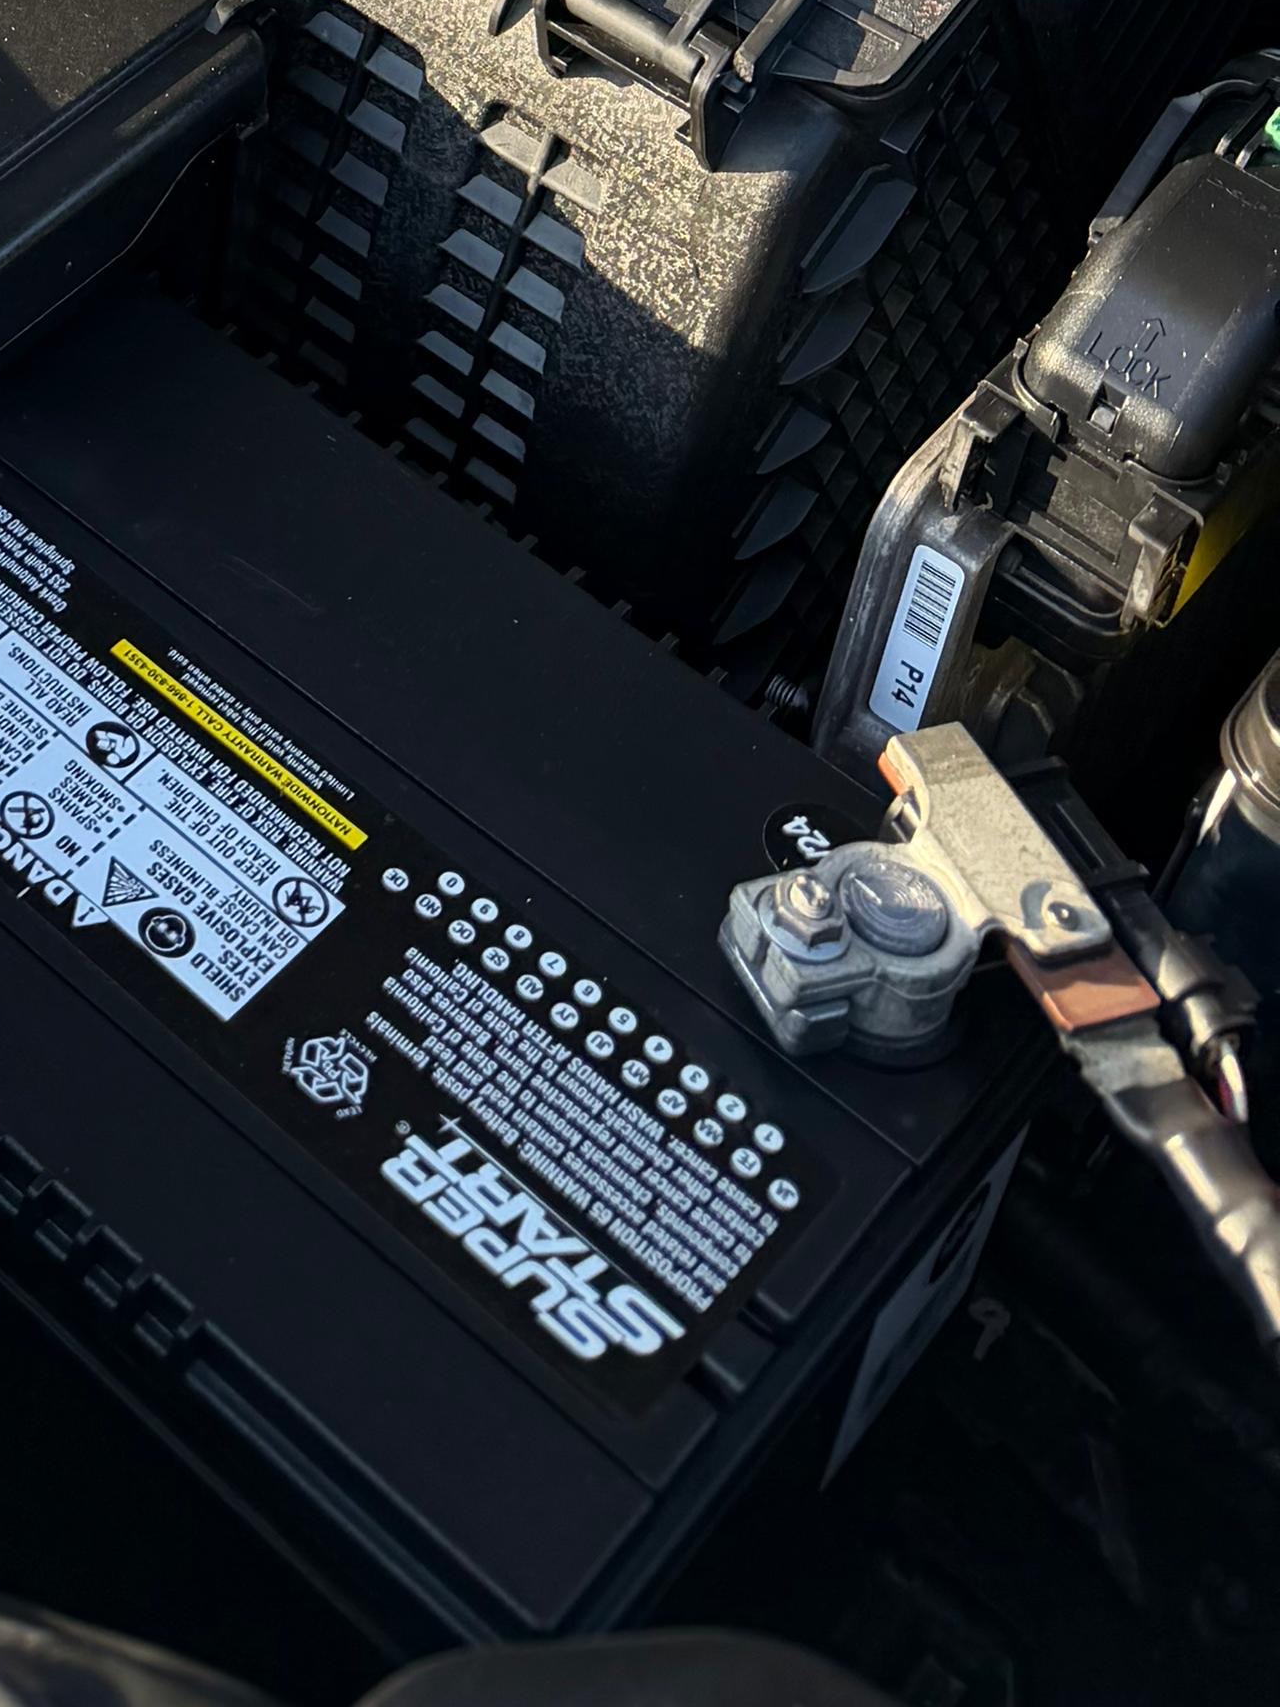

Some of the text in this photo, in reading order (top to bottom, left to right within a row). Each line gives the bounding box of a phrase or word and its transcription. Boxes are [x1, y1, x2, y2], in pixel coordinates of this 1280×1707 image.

[1084, 331, 1172, 399] LOCK
[6, 518, 29, 537] MO
[22, 531, 75, 575] Springfield
[23, 552, 53, 579] South
[37, 585, 68, 613] Ozark
[39, 620, 88, 661] PROPER
[41, 642, 71, 667] NOT
[7, 642, 92, 718] INSTRUCTIONS.
[65, 661, 91, 681] DO
[82, 656, 133, 698] FOLLOW
[86, 674, 130, 715] BURNS.
[891, 660, 925, 708] P14
[0, 698, 48, 740] SEVERE
[23, 676, 81, 728] READ ALL
[124, 709, 150, 730] OR
[131, 692, 159, 721] USE.
[195, 704, 224, 732] CALL
[141, 724, 209, 780] EXPLOSION
[154, 715, 214, 764] INVERTED
[221, 730, 283, 781] WARRANTY
[207, 758, 238, 784] FOR
[207, 774, 239, 805] FIRE,
[156, 768, 281, 876] REACH OF CHILDREN.
[233, 801, 256, 819] OF
[233, 779, 325, 856] RECOMMENDED
[250, 813, 285, 844] RISK
[279, 776, 352, 836] NATIONWIDE
[54, 834, 82, 858] NO
[163, 796, 269, 887] KEEP OUT OF THE
[319, 851, 351, 878] NOT
[282, 838, 344, 894] WARNING:
[145, 861, 275, 974] EXPLOSIVE GASES
[148, 838, 288, 960] CAN CAUSE BLINDNESS
[228, 884, 299, 949] OR INJURY.
[189, 951, 246, 1002] SHIELD
[217, 943, 261, 989] EYES.
[404, 946, 765, 1247] contain other chemicals known to the State of California
[451, 958, 778, 1236] to cause cancer. WASH HANDS AFTER HANDLING.
[382, 1149, 623, 1358] SUPER
[404, 1124, 682, 1353] START
